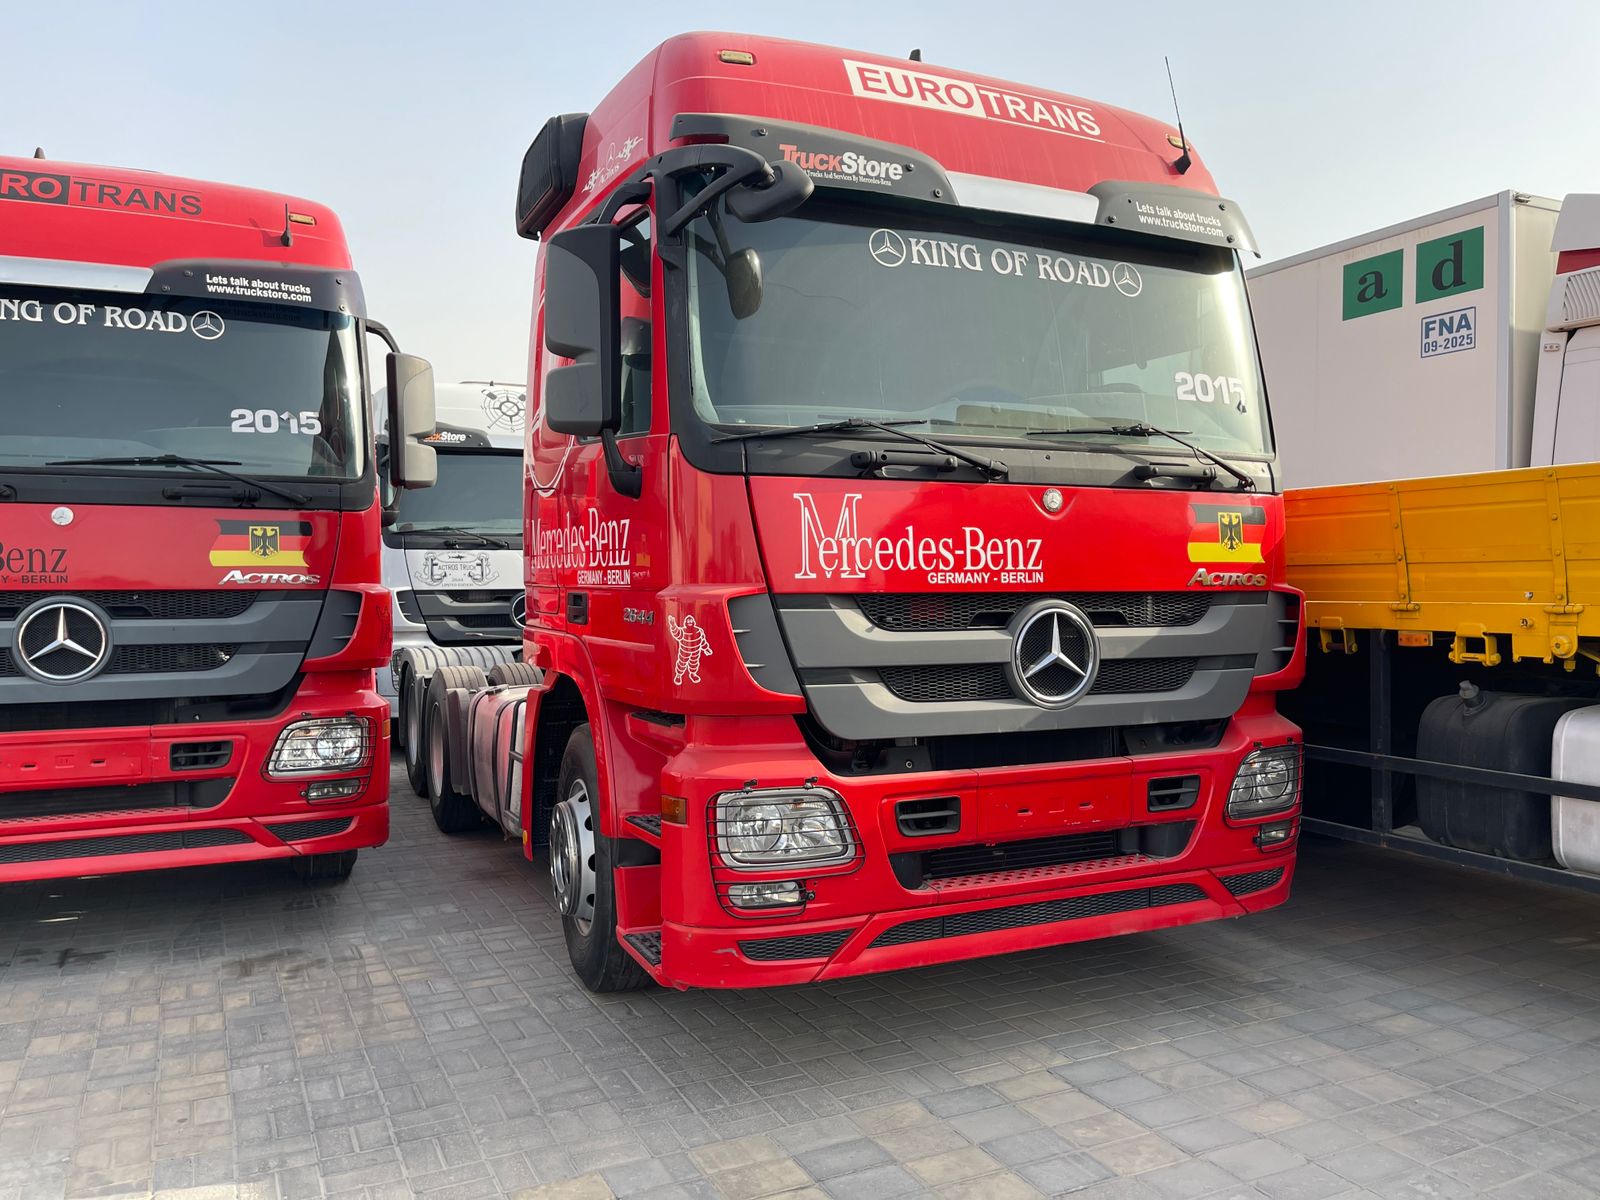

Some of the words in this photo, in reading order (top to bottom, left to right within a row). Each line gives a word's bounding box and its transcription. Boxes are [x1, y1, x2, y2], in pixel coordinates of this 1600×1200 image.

[856, 66, 975, 110] EURO
[978, 89, 1101, 136] TRANS
[779, 143, 903, 180] TruckStore
[0, 173, 63, 199] RO
[73, 181, 202, 216] TRANS
[1135, 201, 1155, 214] Lets
[1155, 205, 1172, 217] talk
[1173, 209, 1195, 221] about
[1196, 213, 1222, 227] trucks
[1138, 214, 1224, 237] www.truckstore.com
[908, 237, 983, 272] KING
[991, 248, 1029, 277] OF
[1035, 254, 1111, 288] ROAD
[1357, 270, 1388, 303] a
[1431, 240, 1467, 291] d
[206, 273, 228, 285] Lets
[230, 276, 249, 287] talk
[251, 279, 279, 290] about
[281, 282, 311, 294] trucks
[207, 284, 312, 302] www.truckstore.com
[53, 302, 96, 325] OF
[103, 306, 188, 333] ROAD
[1424, 312, 1472, 340] FNA
[1423, 333, 1473, 354] 09-2025
[1175, 371, 1246, 408] 2015
[230, 408, 322, 435] 2015
[531, 507, 631, 569] Mercedes-Benz
[793, 493, 1043, 580] Mercedes-Benz
[21, 575, 69, 584] BERLIN
[437, 563, 459, 571] ACTROS
[577, 569, 604, 585] GERMANY
[607, 569, 631, 585] BERLIN
[927, 571, 991, 584] GERMANY
[1000, 571, 1044, 584] BERLIN
[623, 607, 655, 625] 2644
